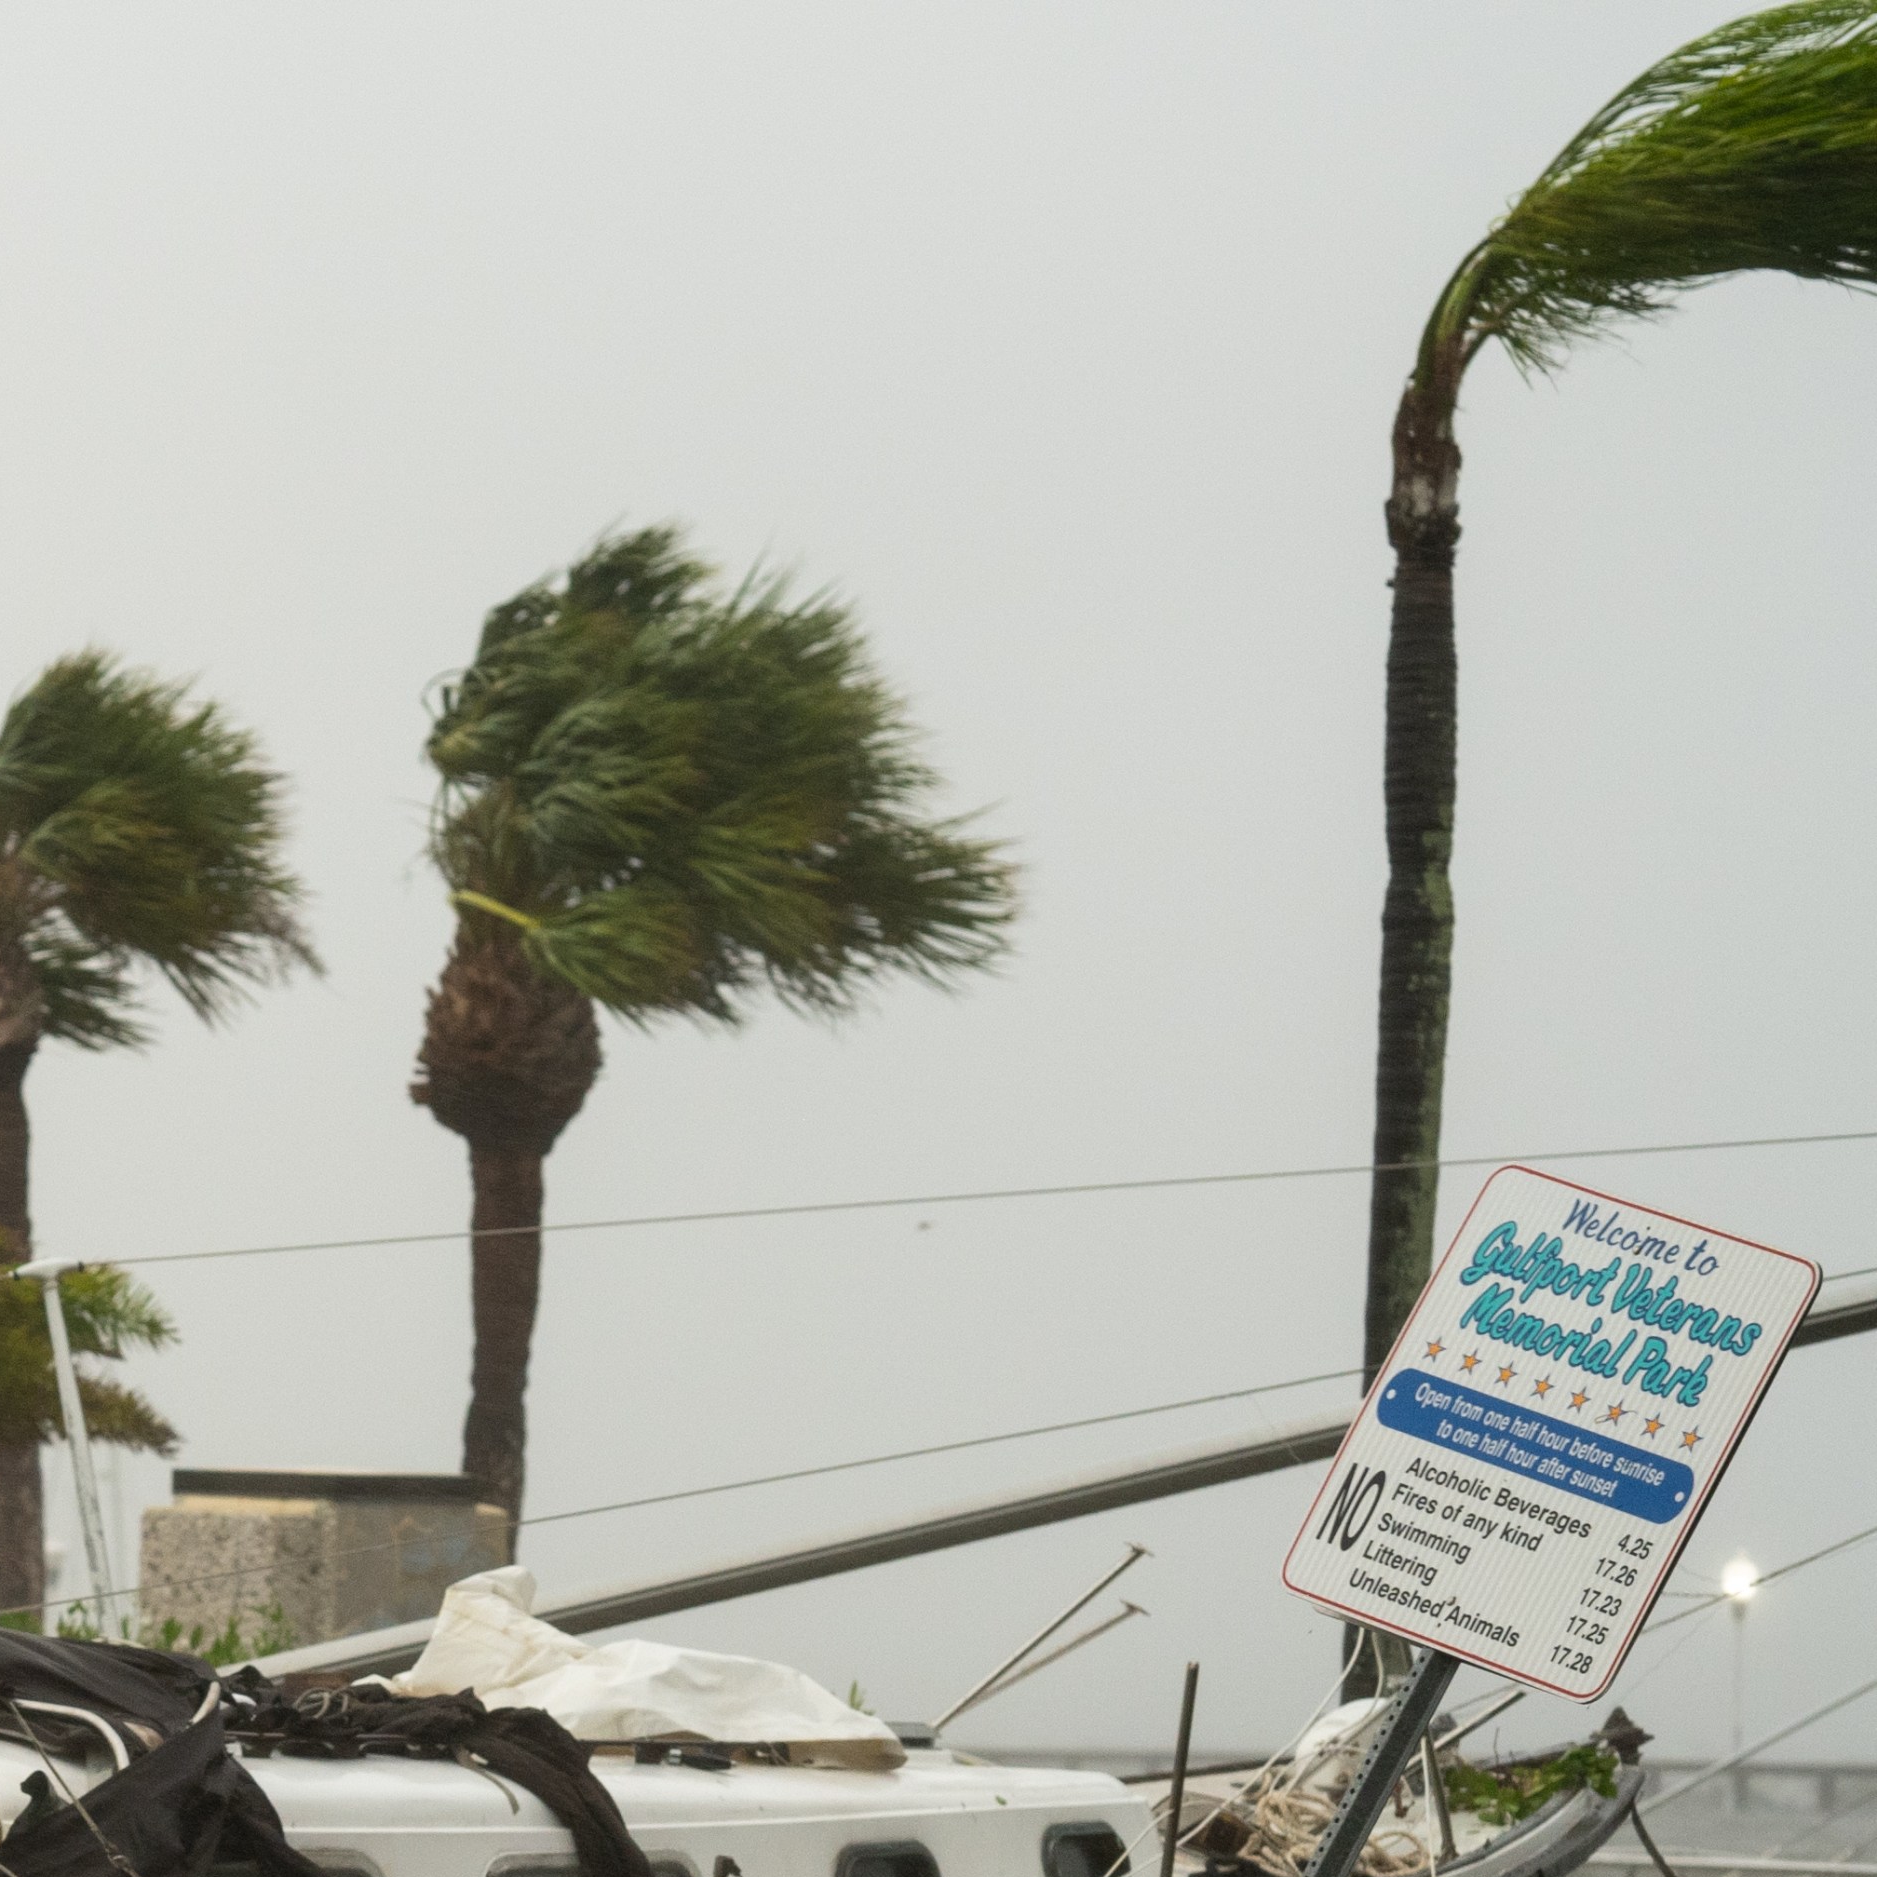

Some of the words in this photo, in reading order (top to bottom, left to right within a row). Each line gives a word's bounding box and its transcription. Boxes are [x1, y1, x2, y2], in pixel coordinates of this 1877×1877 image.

[1562, 1198, 1680, 1264] Welcome
[1684, 1240, 1719, 1276] to
[1460, 1220, 1622, 1307] Gulfport
[1610, 1262, 1763, 1357] Veterans
[1459, 1281, 1638, 1380] Memorial
[1622, 1335, 1714, 1407] Park
[1414, 1382, 1452, 1411] Open
[1452, 1396, 1485, 1422] from
[1483, 1410, 1511, 1432] one
[1509, 1416, 1540, 1442] half
[1537, 1427, 1570, 1452] hour
[1568, 1437, 1616, 1470] before
[1613, 1456, 1666, 1487] sunrise
[1436, 1419, 1452, 1439] to
[1451, 1430, 1480, 1449] one
[1478, 1434, 1509, 1460] half
[1504, 1446, 1539, 1470] hour
[1536, 1456, 1571, 1483] after
[1569, 1467, 1619, 1499] sunset
[1315, 1462, 1387, 1552] NO
[1391, 1482, 1437, 1515] Fires
[1440, 1503, 1463, 1523] of
[1462, 1512, 1499, 1541] any
[1499, 1521, 1544, 1553] kind
[1405, 1456, 1491, 1502] Alcoholic
[1493, 1487, 1592, 1539] Beverages
[1362, 1539, 1439, 1588] Littering
[1377, 1511, 1472, 1566] Swimming
[1595, 1556, 1639, 1588] 17.26
[1617, 1534, 1654, 1560] 4.25
[1348, 1566, 1448, 1620] Unleashed
[1443, 1604, 1521, 1648] Animals
[1566, 1615, 1610, 1646] 17.25
[1579, 1586, 1624, 1618] 17.23
[1549, 1644, 1594, 1675] 17.28
